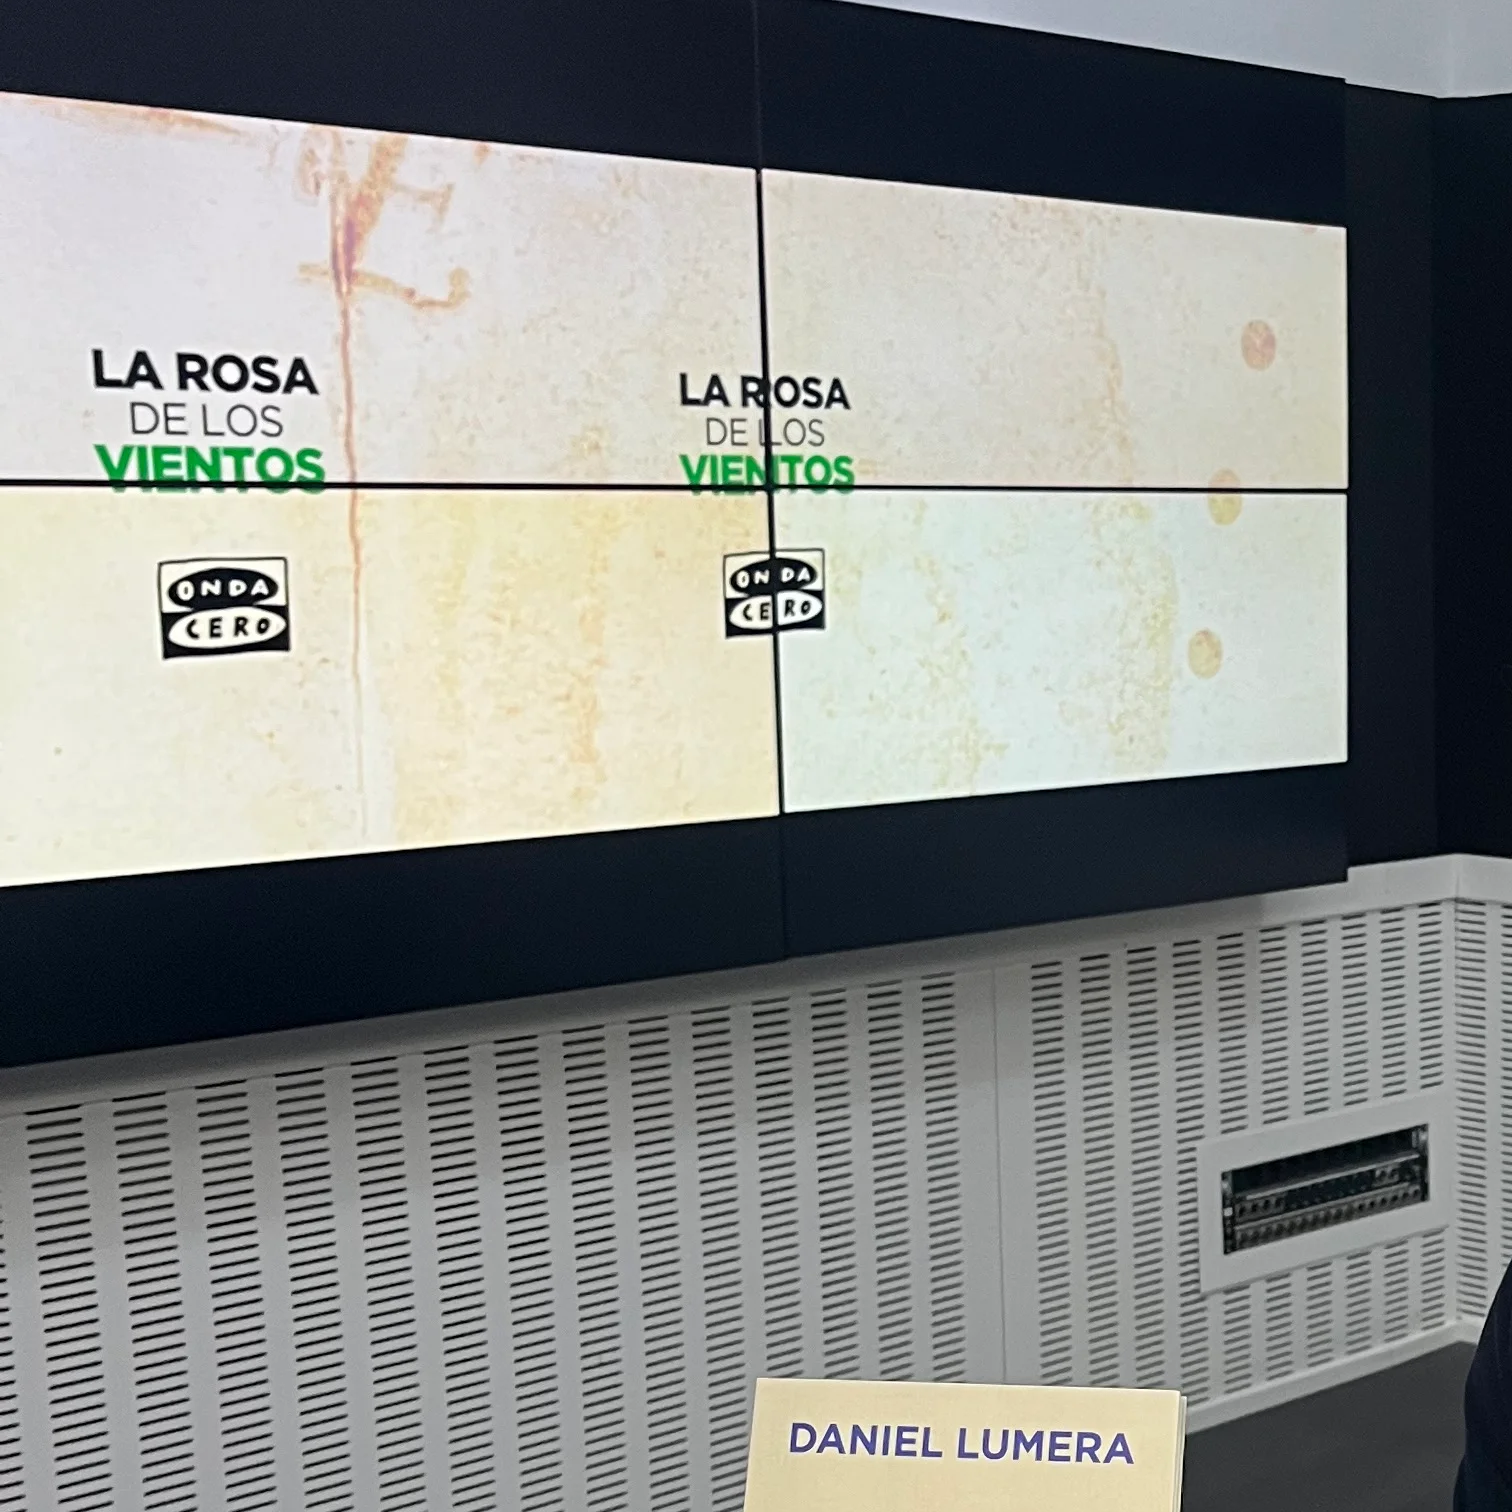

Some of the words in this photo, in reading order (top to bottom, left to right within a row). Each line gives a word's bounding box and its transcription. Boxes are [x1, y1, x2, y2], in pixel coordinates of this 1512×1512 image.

[92, 348, 164, 391] LA
[176, 352, 320, 396] ROSA
[679, 372, 731, 408] LA
[741, 375, 851, 410] ROSA
[129, 401, 188, 436] DE
[202, 403, 283, 437] LOS
[706, 417, 748, 446] DE
[758, 418, 825, 447] LOS
[92, 444, 326, 494] VIENTOS
[678, 453, 855, 495] VIENTOS
[176, 579, 270, 601] ONDA
[737, 567, 811, 589] ONDA
[186, 616, 270, 640] CERO
[743, 599, 811, 621] CERO
[789, 1422, 943, 1458] DANIEL
[957, 1427, 1135, 1465] LUMERA
